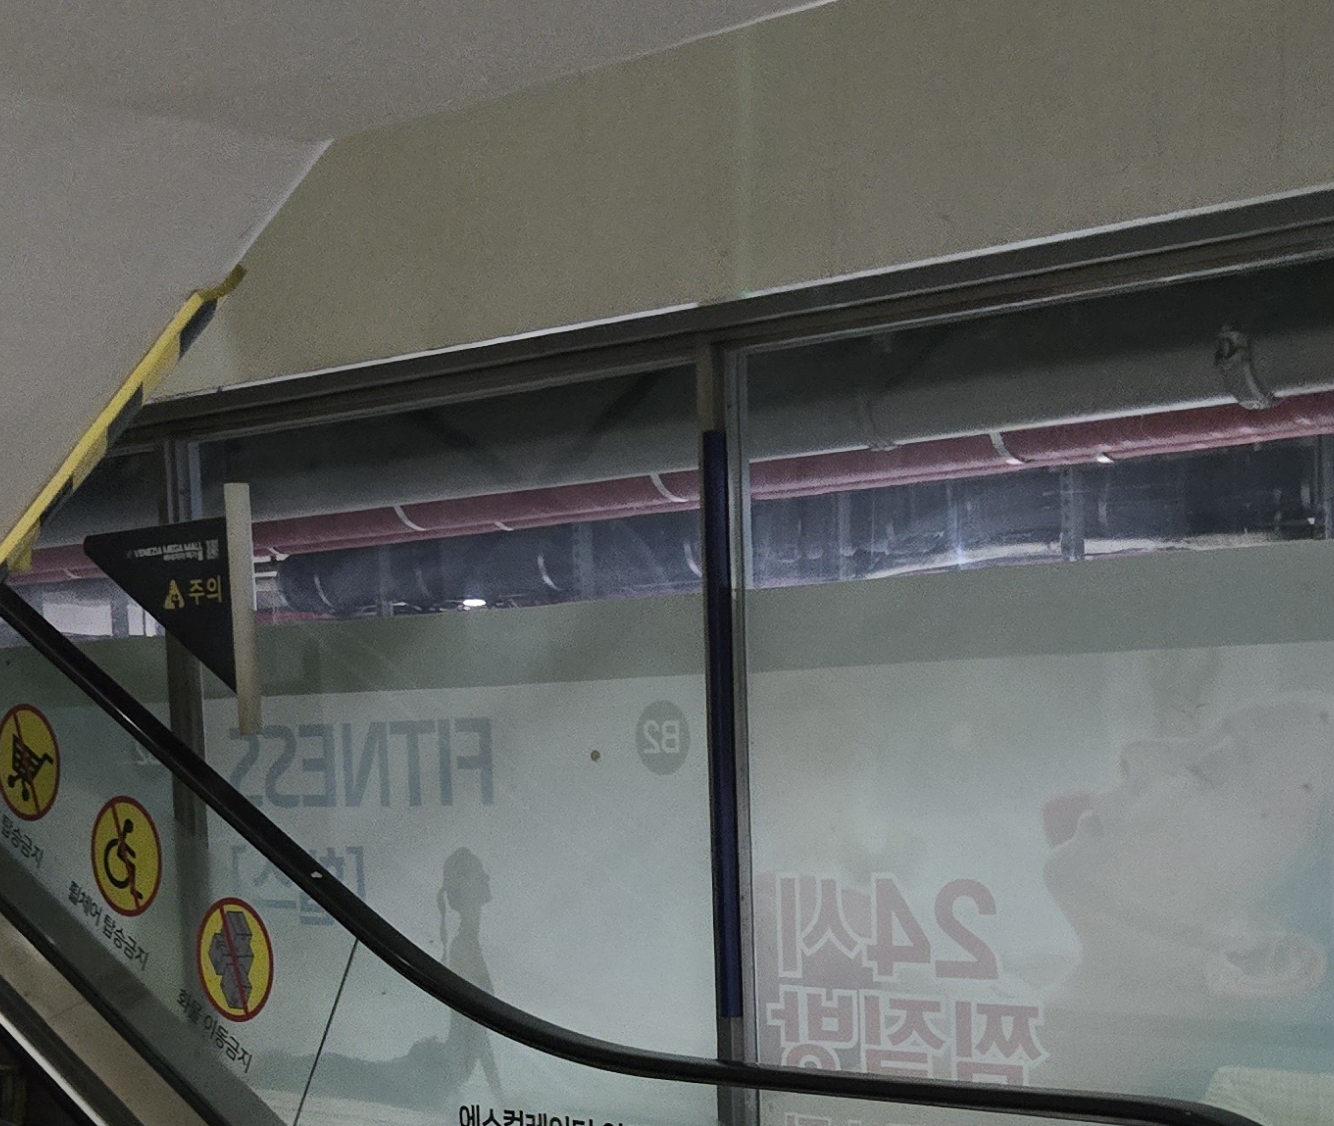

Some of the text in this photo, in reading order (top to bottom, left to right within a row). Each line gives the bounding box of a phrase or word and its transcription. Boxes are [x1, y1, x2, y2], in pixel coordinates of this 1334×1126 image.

[188, 574, 223, 605] 주의
[1, 815, 45, 869] 탑승금지
[68, 879, 149, 971] 휠체어 탑승금지
[177, 988, 253, 1074] 화물 이동금지
